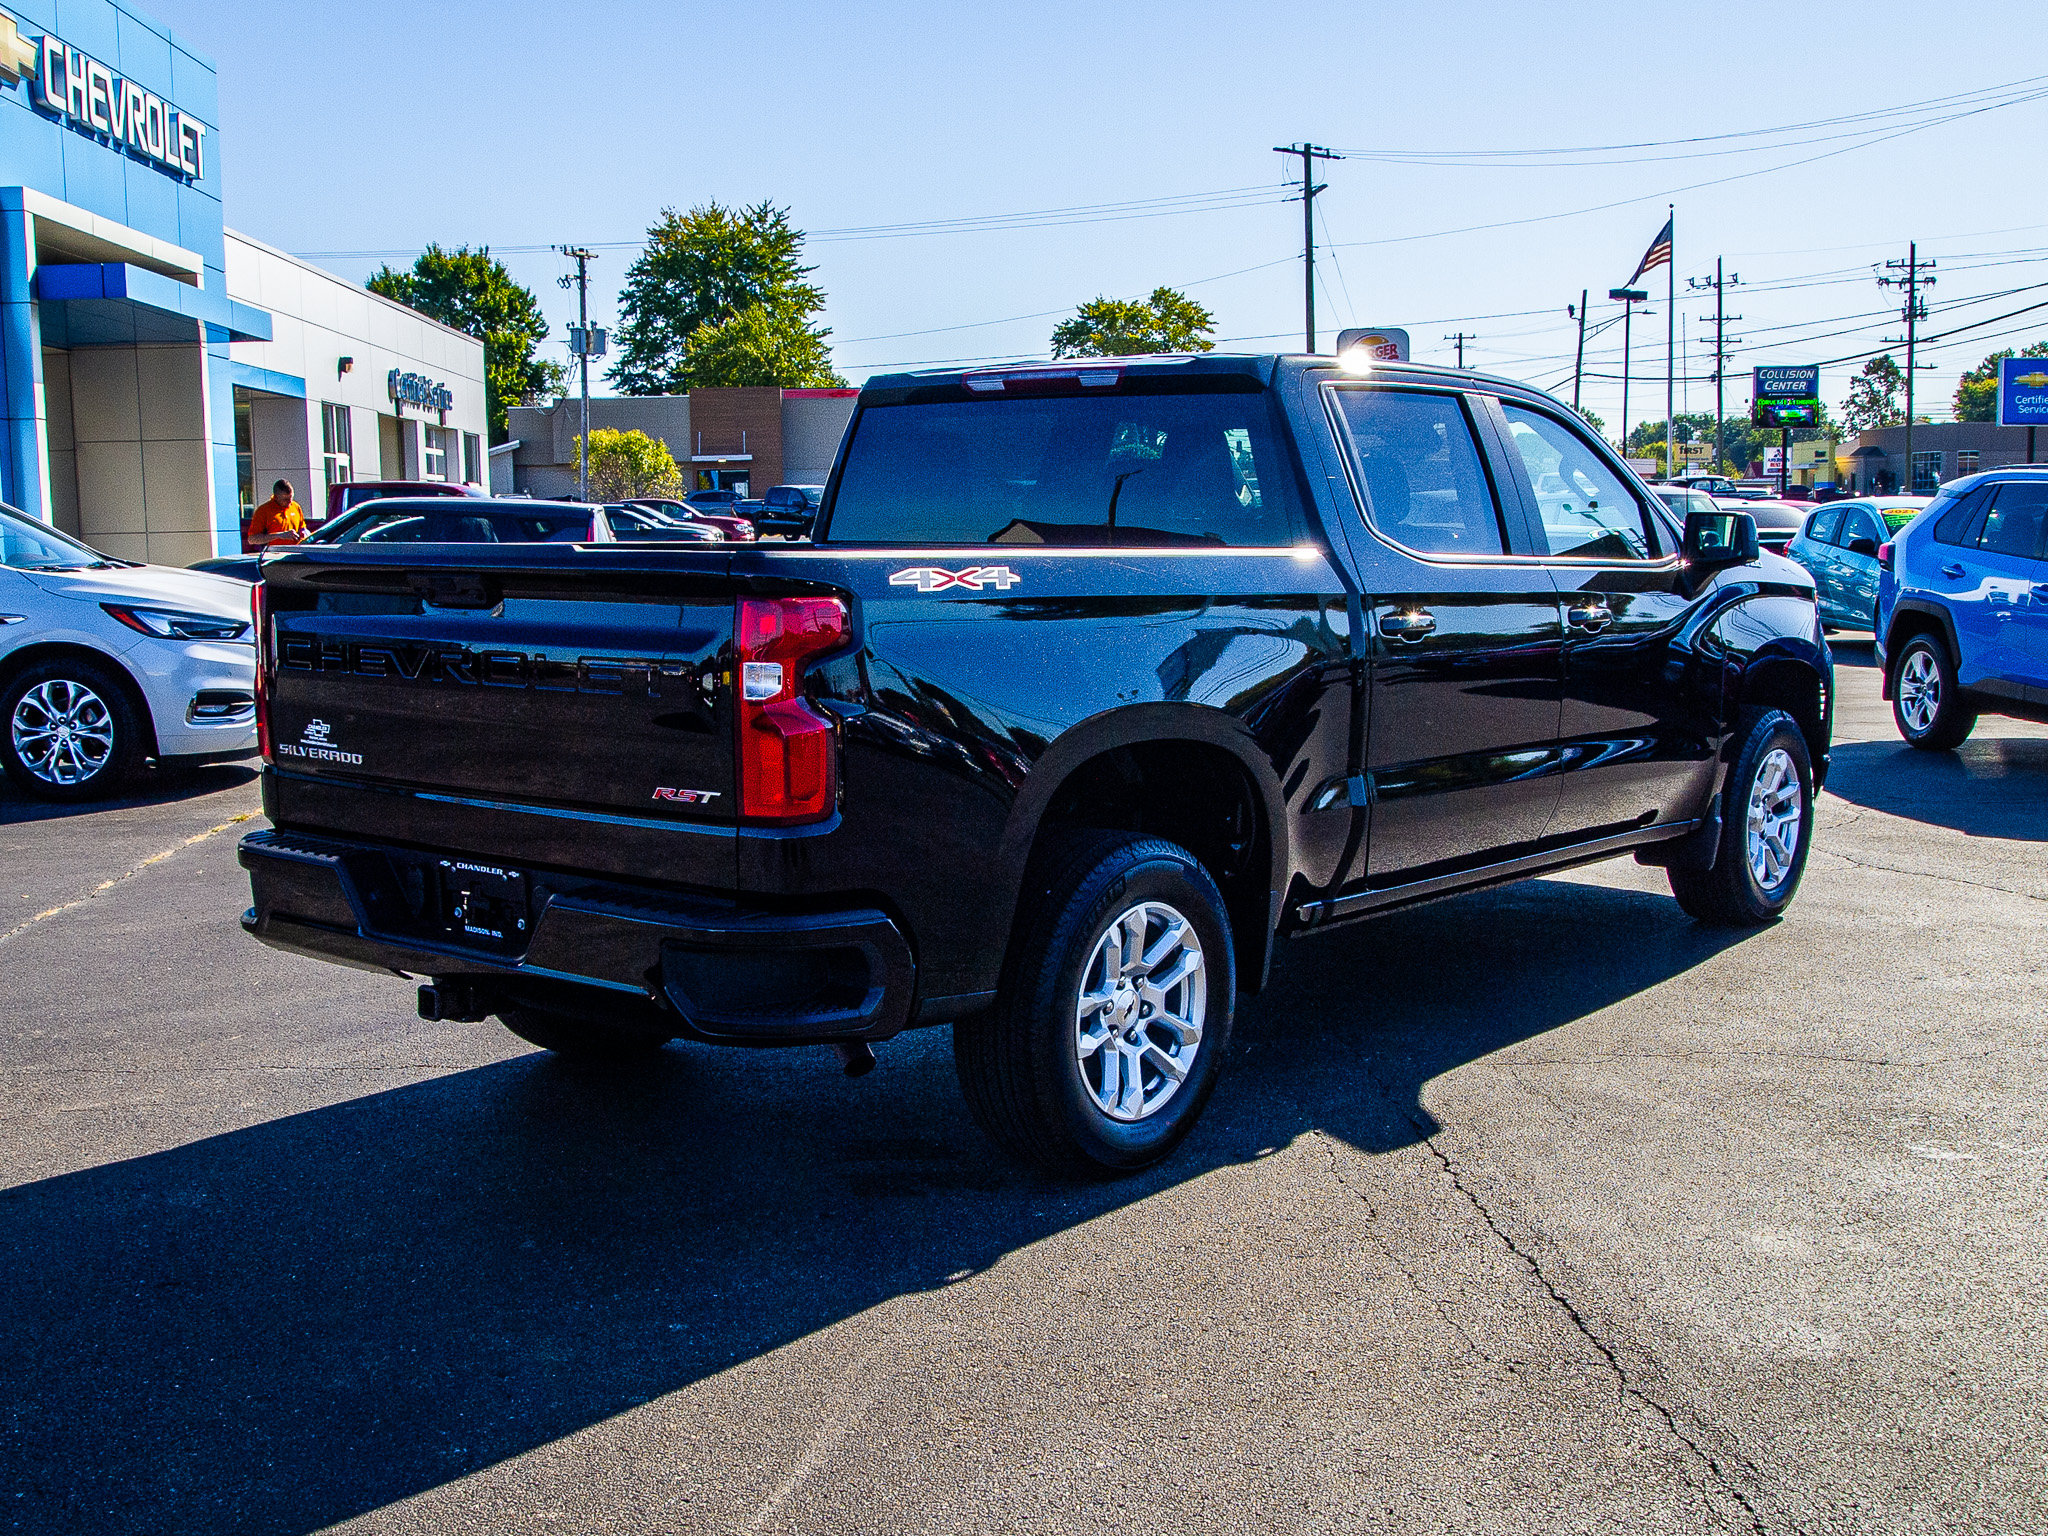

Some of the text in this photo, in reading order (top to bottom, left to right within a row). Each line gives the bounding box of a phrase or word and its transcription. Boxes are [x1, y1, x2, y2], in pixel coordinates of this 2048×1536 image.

[43, 35, 207, 180] CHEVROLET
[1760, 370, 1815, 379] COLLISION
[1765, 381, 1807, 390] CENTER
[2015, 395, 2048, 404] Certifie
[2018, 405, 2048, 414] Servic
[282, 638, 686, 698] CHEVROLET
[279, 744, 363, 765] SILVERADO
[652, 787, 721, 803] RST
[456, 862, 503, 876] CHANDLER
